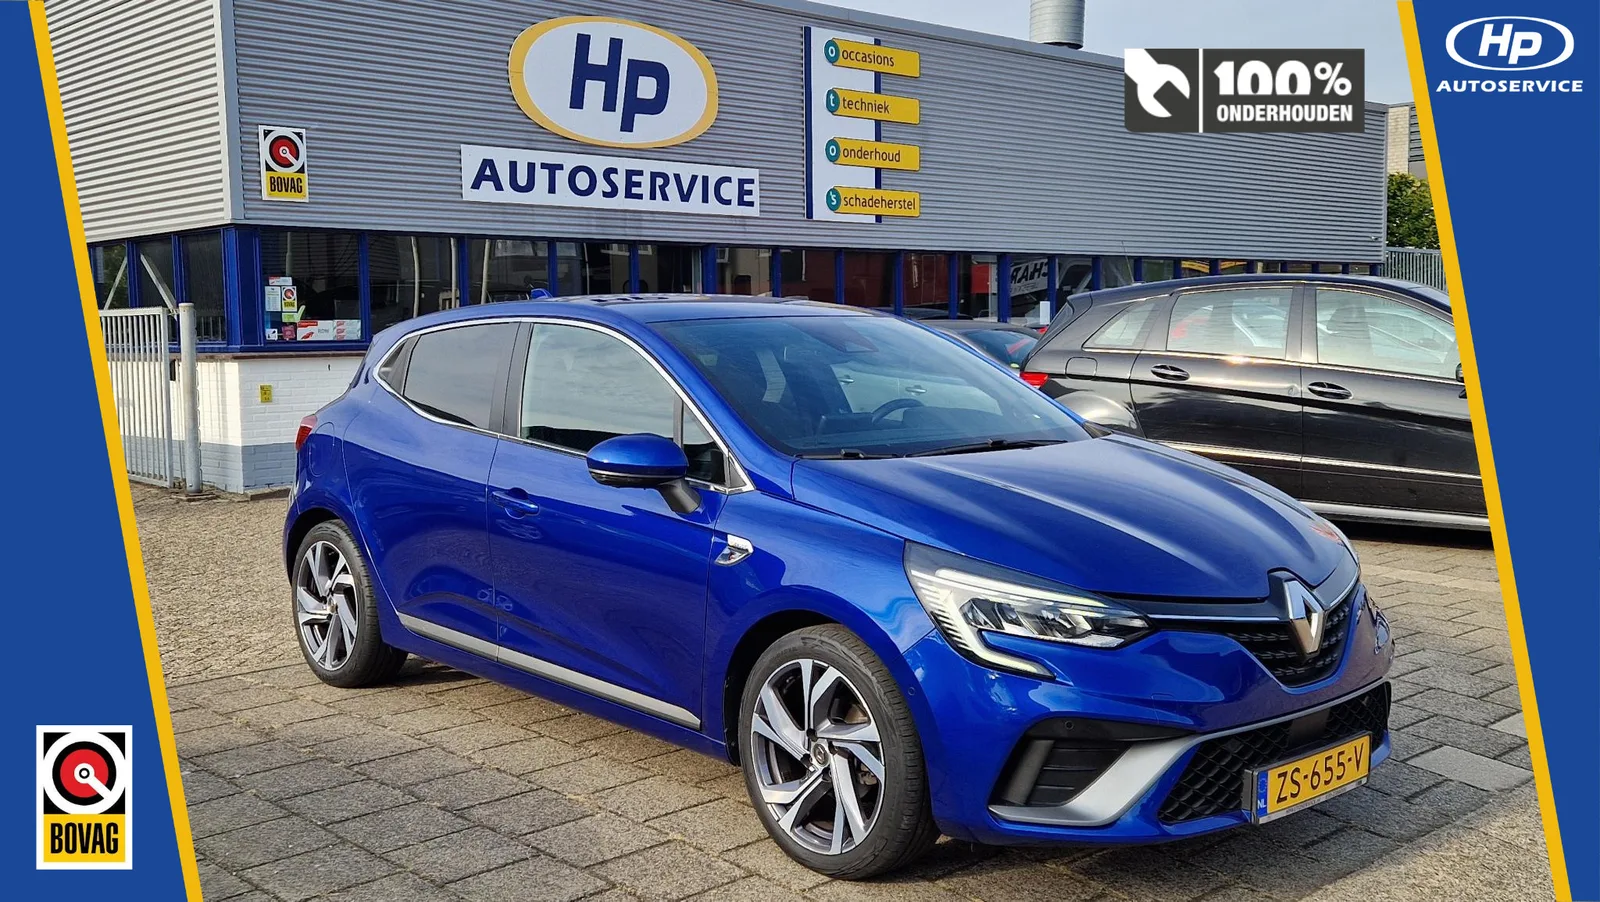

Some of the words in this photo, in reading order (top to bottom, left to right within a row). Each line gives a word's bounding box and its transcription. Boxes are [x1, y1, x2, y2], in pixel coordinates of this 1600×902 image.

[842, 49, 895, 67] occasions
[842, 96, 890, 115] techniek
[842, 146, 901, 163] onderhoud
[269, 175, 303, 194] BOVAG
[470, 158, 755, 207] AUTOSERVICE
[843, 193, 916, 211] schadeherstel
[1257, 798, 1267, 809] NL
[1276, 742, 1364, 804] ZS-655-V
